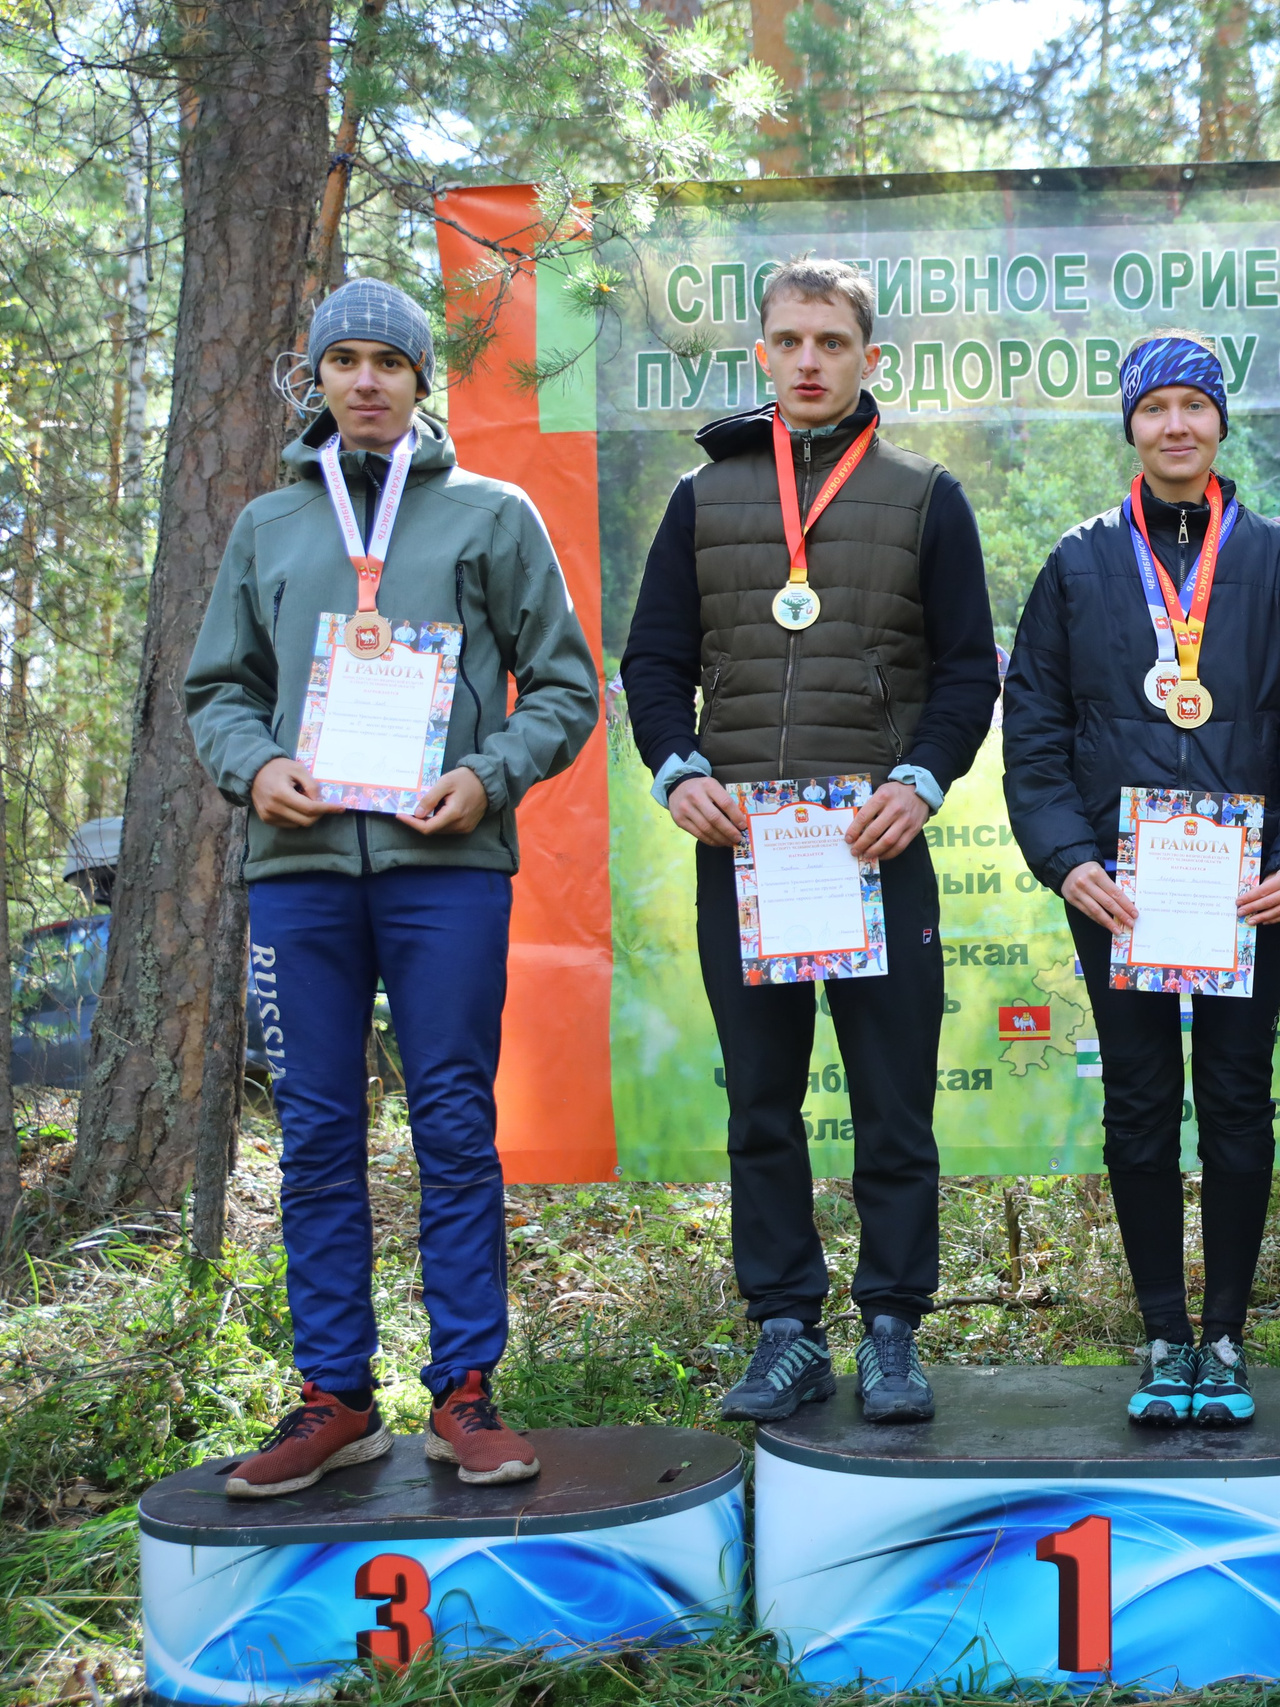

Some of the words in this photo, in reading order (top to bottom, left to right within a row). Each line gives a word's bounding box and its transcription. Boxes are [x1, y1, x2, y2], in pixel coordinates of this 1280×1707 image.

[667, 252, 1088, 324] СПИВНОЕ
[869, 334, 1257, 414] ЗДОРОВУ
[377, 496, 396, 540] ОБЛАСТЬ
[814, 476, 841, 513] ОБЛАСТЬ
[1205, 496, 1219, 558] ЧЕЛЯБИНСКАЯ
[1196, 559, 1211, 602] ОБЛАСТЬ
[343, 660, 426, 679] ГРАМОТА
[762, 823, 844, 840] ГРАМОТА
[1149, 836, 1230, 853] ГРАМОТА
[252, 943, 287, 1080] RUSSIA
[355, 1553, 435, 1681] 3
[1036, 1514, 1112, 1673] 1
